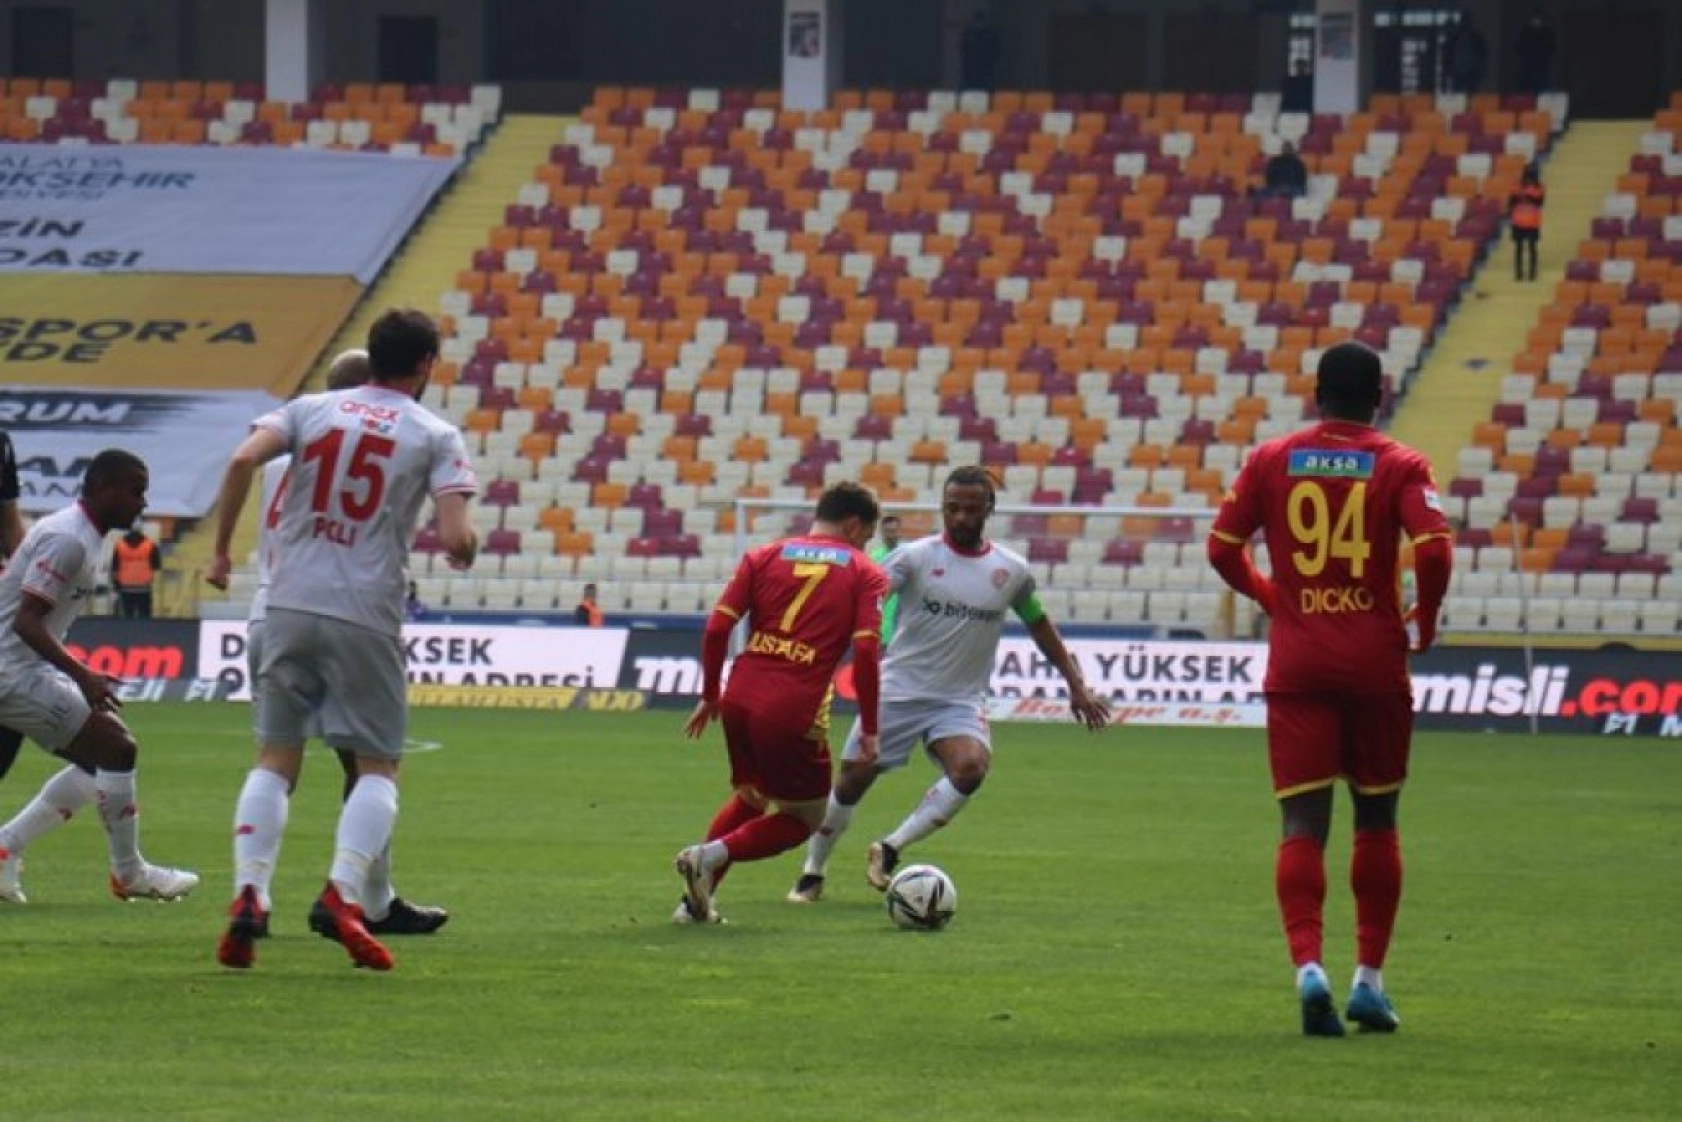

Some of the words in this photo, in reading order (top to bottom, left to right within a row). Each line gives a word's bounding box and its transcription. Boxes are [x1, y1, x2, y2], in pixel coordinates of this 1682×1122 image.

[303, 427, 396, 521] 15
[1287, 480, 1371, 579] 94
[780, 563, 830, 632] 7
[1301, 587, 1374, 614] DICKO
[1095, 645, 1253, 683] YÜKSEK
